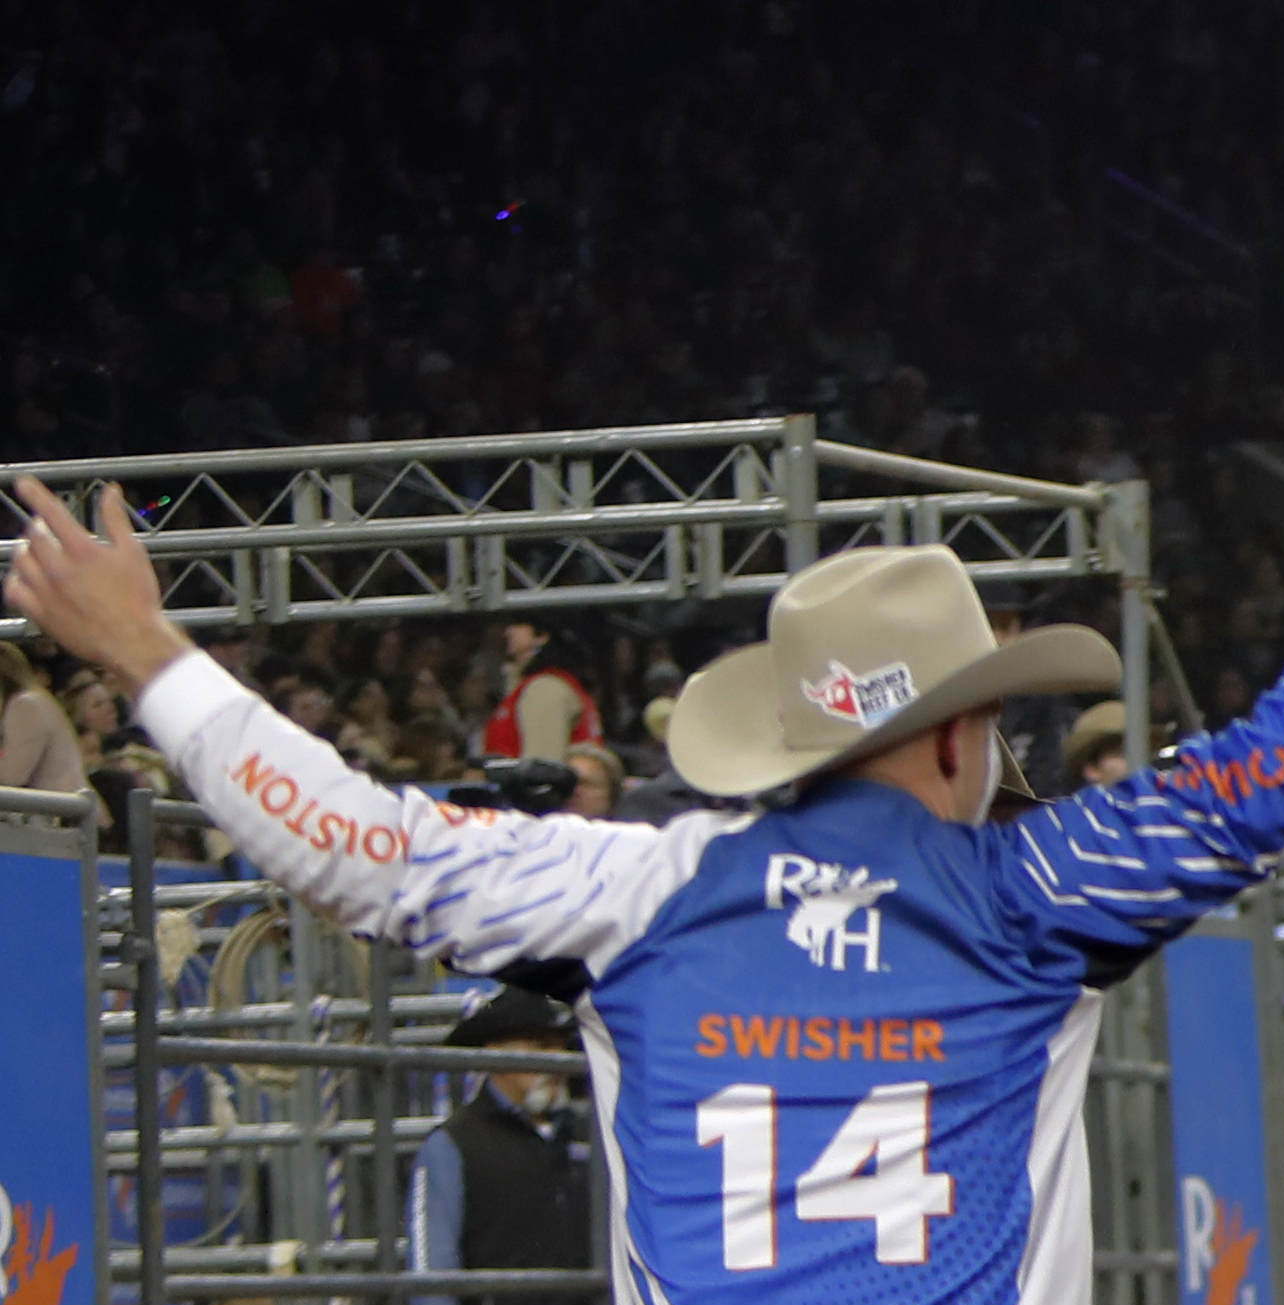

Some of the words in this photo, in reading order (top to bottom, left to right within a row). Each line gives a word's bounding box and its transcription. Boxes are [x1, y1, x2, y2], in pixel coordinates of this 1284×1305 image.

[765, 852, 818, 910] R
[831, 906, 882, 973] H
[694, 1012, 948, 1063] SWISHER
[697, 1080, 956, 1273] 14
[1182, 1174, 1216, 1293] R
